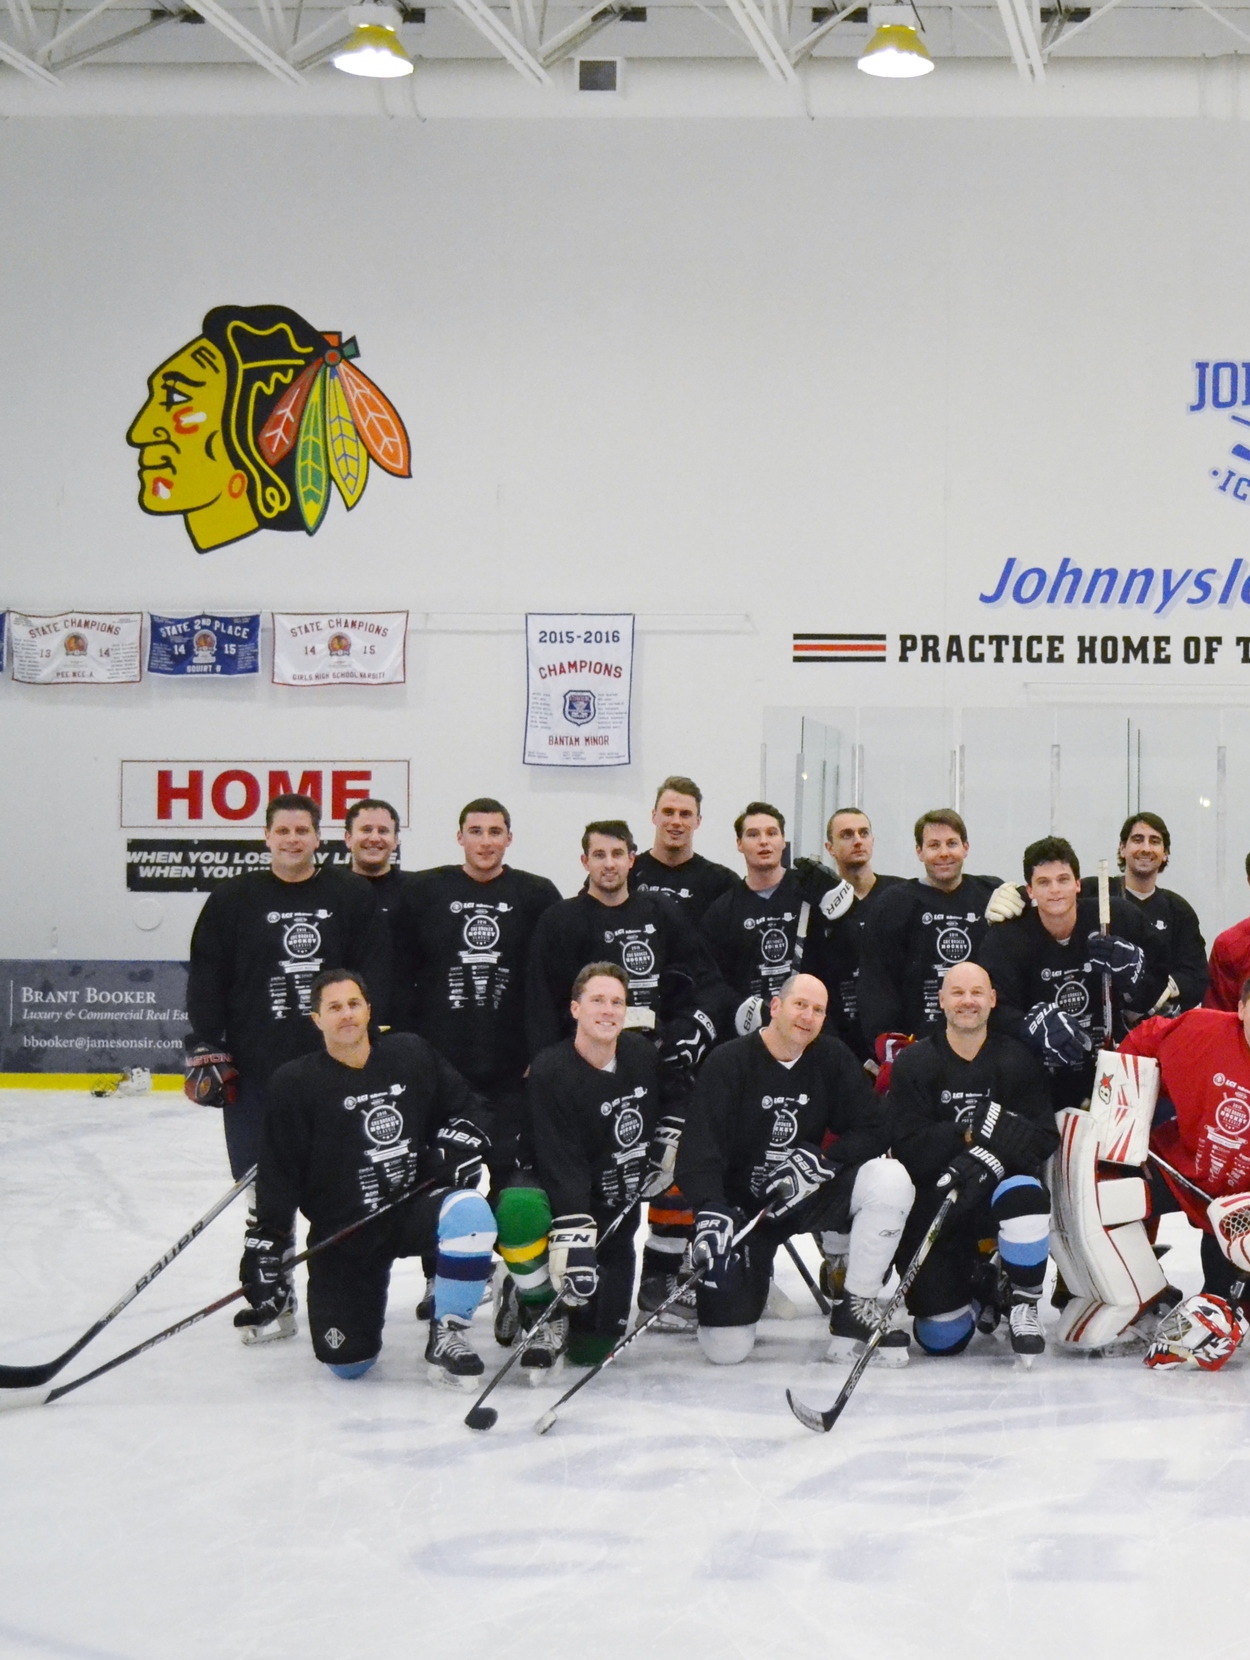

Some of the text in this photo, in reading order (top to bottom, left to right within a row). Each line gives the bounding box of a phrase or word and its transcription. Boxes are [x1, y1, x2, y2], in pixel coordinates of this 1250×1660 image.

[29, 618, 121, 639] STATE CHAMPIONS
[159, 618, 250, 639] STATE 2ND PLACE
[290, 618, 389, 637] STATE CHAMPIONS
[538, 630, 621, 644] 2015-2016
[173, 644, 186, 655] 14
[224, 643, 236, 654] 15
[304, 646, 316, 655] 14
[363, 645, 376, 655] 15
[899, 634, 1064, 665] PRACTICE
[1077, 635, 1171, 665] HOME
[1183, 635, 1223, 665] OF
[538, 660, 623, 680] CHAMPIONS
[548, 735, 610, 746] BANTAM MINOR
[126, 852, 183, 864] WHEN
[188, 852, 229, 864] YOU
[233, 852, 272, 864] LOS
[138, 865, 242, 879] WHEN YOU
[22, 987, 156, 1004] BRANT BOOKER
[22, 1009, 62, 1023] Luxury
[65, 1010, 76, 1020] &
[78, 1008, 144, 1020] Commercial
[145, 1009, 170, 1020] Real
[23, 1035, 183, 1050] bbooker@jamesonsir.com
